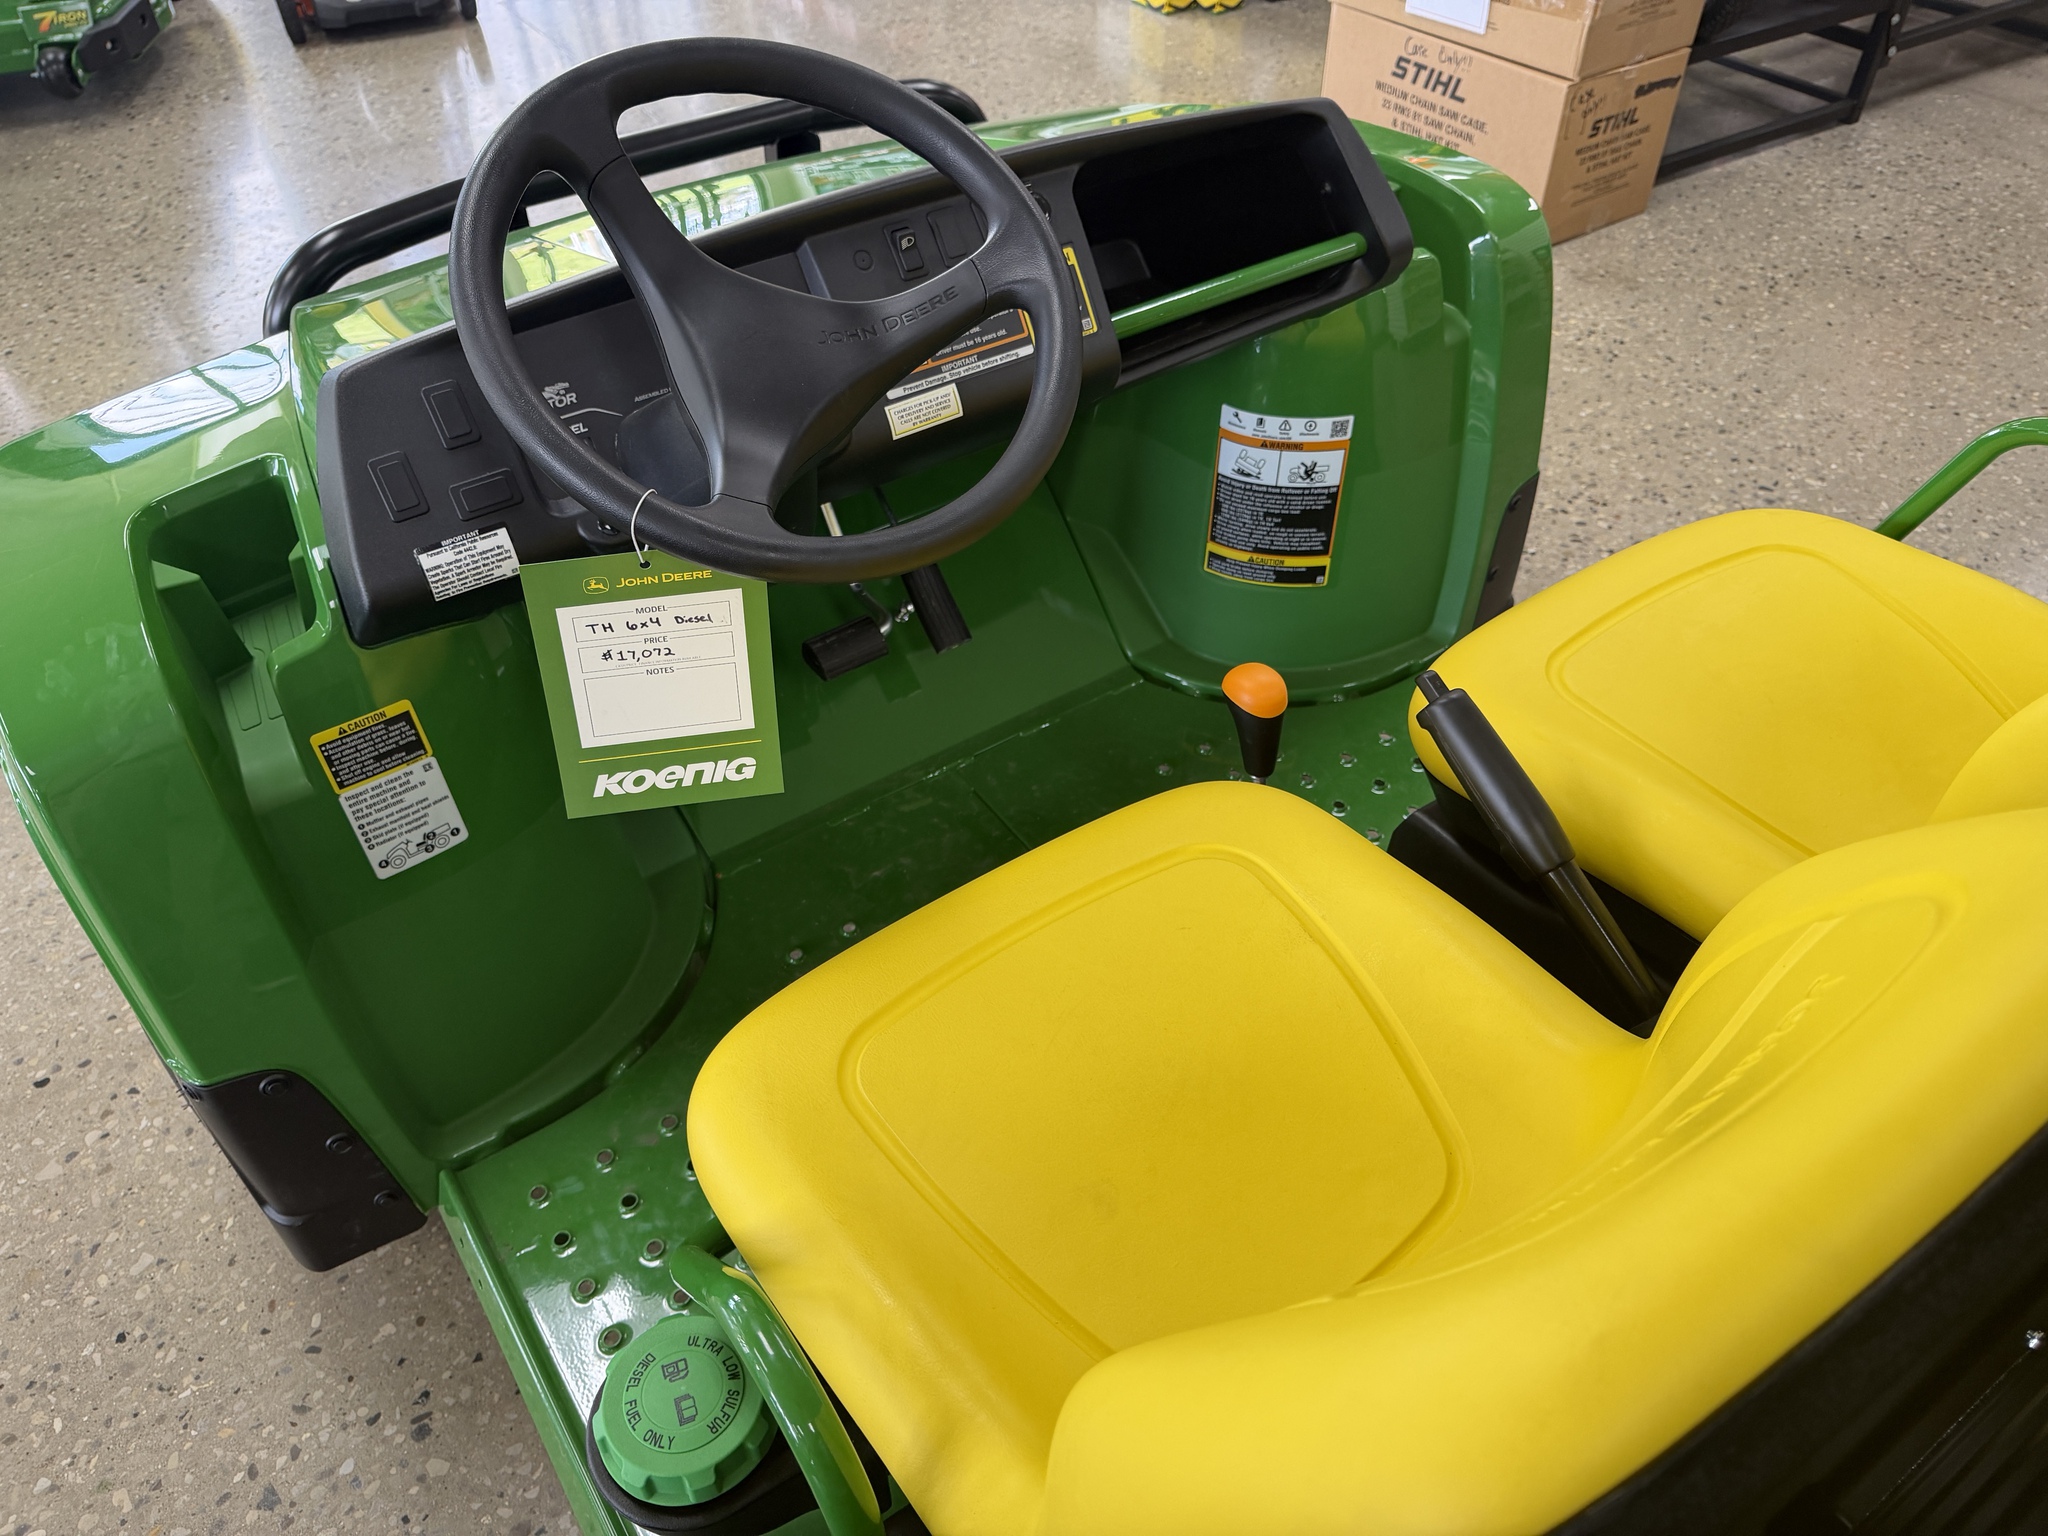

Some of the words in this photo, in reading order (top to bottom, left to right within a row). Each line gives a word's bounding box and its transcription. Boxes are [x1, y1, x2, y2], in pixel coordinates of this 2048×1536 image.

[1390, 55, 1466, 103] STIHL
[1376, 81, 1408, 101] MEDIUM
[1410, 95, 1436, 112] CHAIN
[1440, 106, 1458, 121] SAW
[1424, 116, 1443, 130] SAW
[1588, 106, 1640, 139] STIHL
[818, 325, 879, 345] JOHN
[881, 286, 959, 333] DEERE
[952, 342, 966, 350] must
[982, 333, 997, 343] years
[997, 329, 1007, 337] old.
[903, 382, 924, 393] Prevent
[924, 375, 947, 386] Damage.
[949, 370, 962, 378] Stop
[962, 364, 981, 374] vehicle
[981, 359, 998, 368] before
[999, 352, 1020, 362] shifting.
[941, 355, 978, 372] IMPORTANT
[547, 392, 577, 408] TOR
[634, 389, 668, 402] ASSEMBLED
[894, 406, 913, 416] CHARGES
[905, 408, 924, 418] DELIVERY
[935, 398, 951, 407] SERVICE
[919, 413, 941, 424] WARRANTY
[932, 404, 951, 414] COVERED
[571, 422, 588, 434] EL
[1269, 442, 1304, 451] WARNING
[1252, 484, 1267, 492] Death
[1268, 485, 1280, 493] from
[1281, 486, 1304, 494] Rollover
[1310, 486, 1329, 495] Falling
[441, 529, 479, 546] IMPORTANT
[426, 549, 444, 557] Pursuant
[448, 542, 467, 551] California
[444, 558, 463, 567] Operation
[476, 547, 496, 557] Equipment
[1255, 558, 1284, 566] CAUTION
[616, 576, 659, 588] JOHN
[661, 570, 712, 583] DEERE
[635, 605, 668, 615] MODEL
[585, 622, 615, 635] TH
[626, 617, 662, 630] 6x4
[674, 613, 713, 625] Diesel
[644, 636, 668, 645] PRICE
[646, 666, 674, 675] NOTES
[347, 711, 387, 732] CAUTION
[326, 740, 342, 749] Avoid
[342, 728, 372, 743] equipment
[371, 724, 385, 732] fires.
[328, 738, 365, 755] Accumulation
[388, 721, 406, 731] leaves
[331, 752, 342, 760] and
[342, 747, 356, 756] other
[357, 741, 374, 750] debris
[340, 752, 361, 763] moving
[361, 746, 375, 755] parts
[385, 736, 401, 744] cause
[336, 759, 356, 770] Inspect
[356, 751, 379, 762] machine
[341, 772, 354, 781] Shut
[362, 762, 380, 772] engine
[381, 757, 391, 765] and
[392, 752, 406, 760] allow
[350, 763, 363, 771] after
[344, 774, 366, 785] machine
[373, 766, 385, 774] cool
[385, 759, 402, 769] before
[344, 788, 370, 802] Inspect
[370, 783, 383, 792] and
[384, 776, 402, 786] clean
[403, 770, 413, 778] the
[348, 798, 368, 809] entire
[369, 786, 397, 800] machine
[398, 779, 411, 788] and
[351, 807, 364, 816] pay
[365, 796, 389, 810] special
[390, 784, 418, 800] attention
[354, 812, 373, 822] these
[374, 798, 404, 814] locations:
[366, 817, 384, 826] Muffler
[395, 803, 414, 814] exhaust
[415, 797, 429, 806] pipes
[369, 823, 388, 833] Exhaust
[389, 813, 410, 825] manifold
[432, 795, 449, 805] shields
[372, 832, 384, 840] Skid
[384, 827, 397, 836] plate
[405, 813, 429, 826] equipped)
[375, 835, 397, 846] Radiator
[404, 821, 429, 834] equipped)
[687, 1335, 724, 1357] ULTRA
[626, 1353, 656, 1392] DIESEL
[722, 1357, 741, 1381] LOW
[625, 1399, 642, 1432] FUEL
[707, 1389, 739, 1435] SULFUR
[643, 1429, 675, 1450] ONLY
